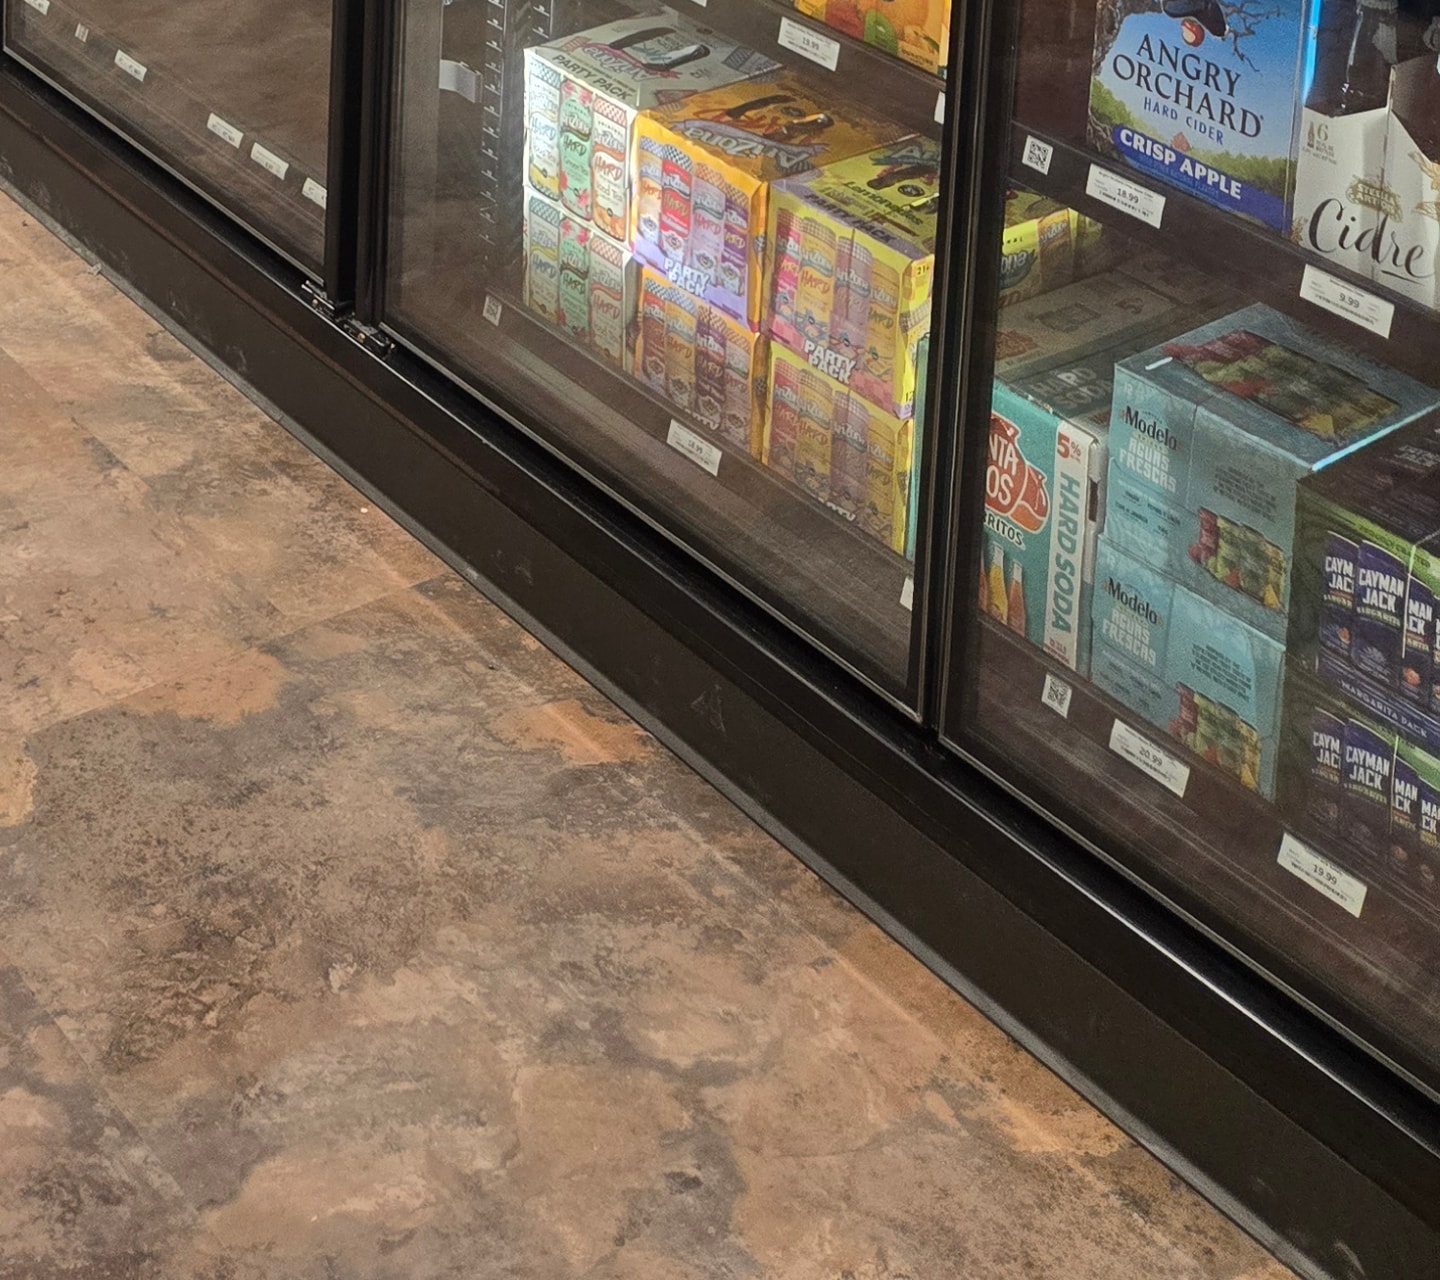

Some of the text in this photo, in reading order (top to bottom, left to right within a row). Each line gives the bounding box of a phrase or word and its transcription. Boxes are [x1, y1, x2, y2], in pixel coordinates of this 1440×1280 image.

[801, 37, 821, 50] 19.99
[552, 54, 635, 99] PARTY PACK
[1136, 33, 1242, 98] ANGRY
[1112, 53, 1262, 138] ORCHARD
[1144, 96, 1224, 145] HARD CIDER
[1317, 123, 1328, 142] 6
[1120, 128, 1242, 200] CRISP APPLE
[1116, 187, 1140, 204] 18.99
[1357, 181, 1392, 204] STELLA
[803, 193, 849, 224] PARTY
[1308, 197, 1438, 278] Cidre
[663, 257, 710, 285] PARTY
[668, 271, 706, 297] PACK
[1339, 293, 1360, 308] 9.99
[804, 339, 857, 371] PARTY
[808, 352, 851, 383] PACK
[1124, 405, 1178, 451] Modelo
[1119, 450, 1177, 491] FRESCAS
[1051, 471, 1081, 634] HARD SODA
[1358, 568, 1405, 598] CAYMAN
[1107, 576, 1159, 625] Modelo
[1362, 588, 1396, 614] JACK
[1102, 621, 1157, 667] FRESCAS
[1339, 678, 1428, 738] MARGARITA PACK
[1138, 747, 1163, 767] 20.99
[1346, 745, 1390, 777] CAYMAN
[1349, 764, 1383, 790] JACK
[1311, 863, 1338, 886] 19.99
